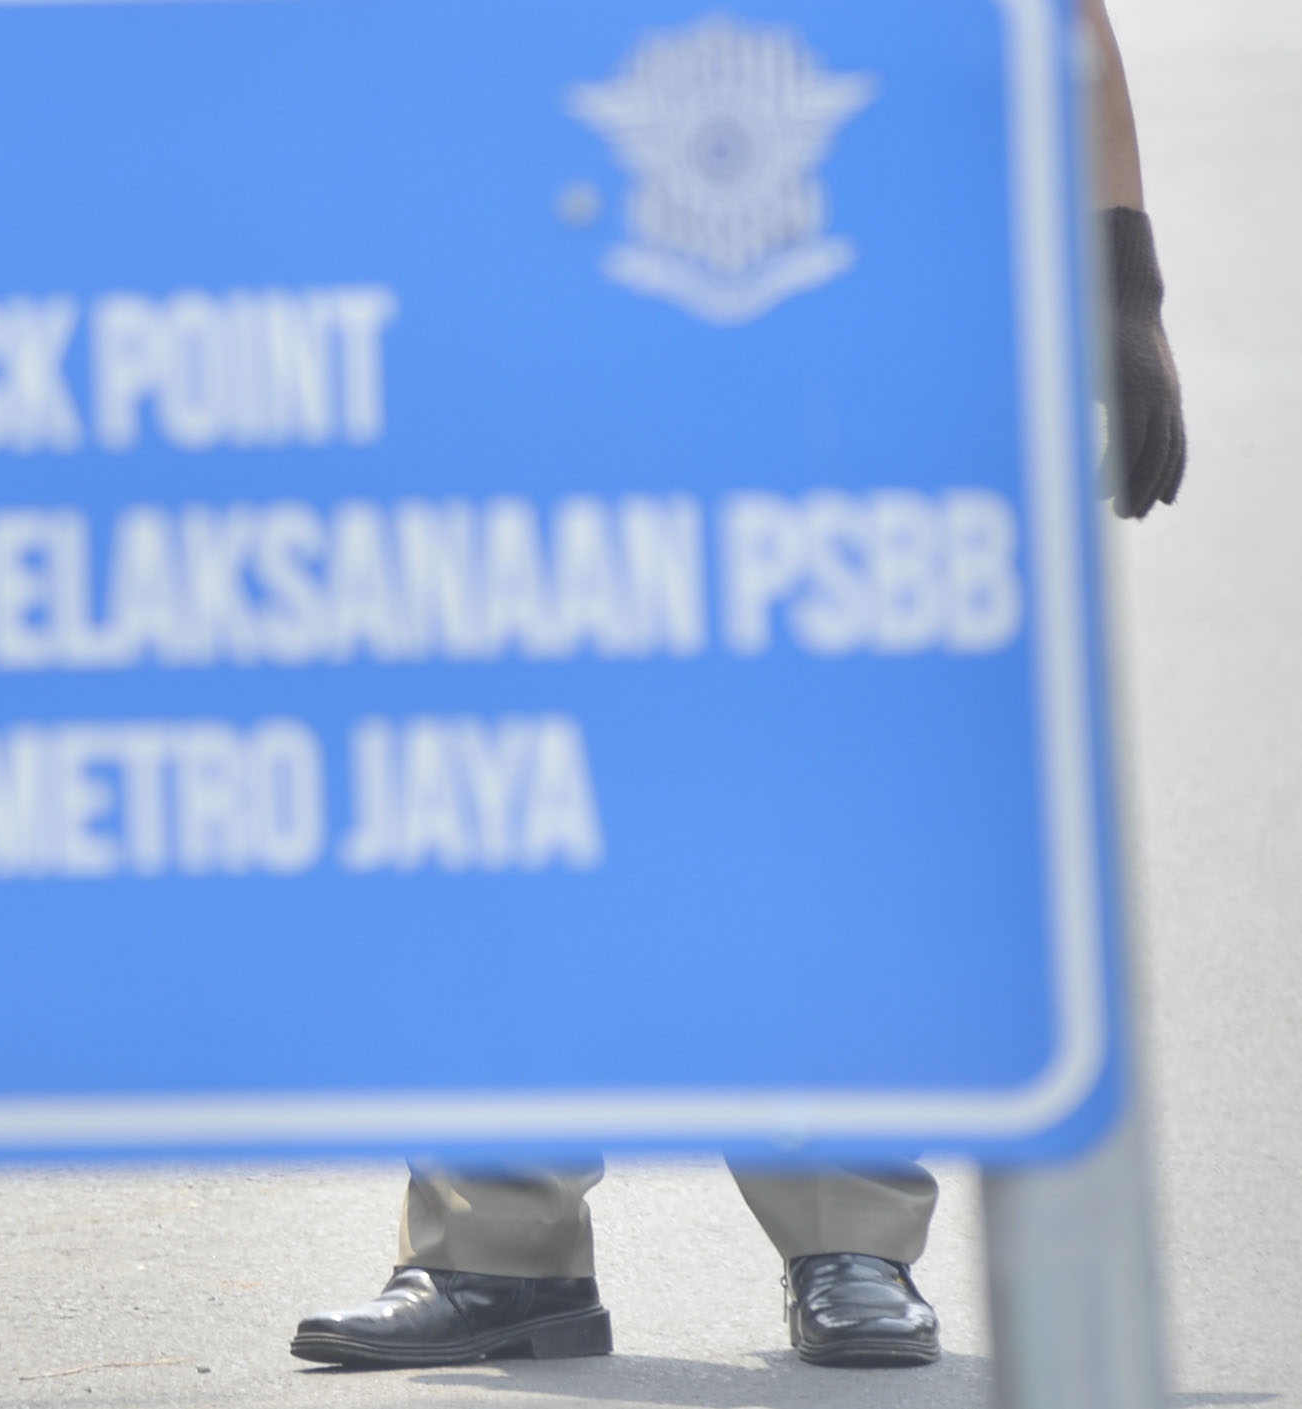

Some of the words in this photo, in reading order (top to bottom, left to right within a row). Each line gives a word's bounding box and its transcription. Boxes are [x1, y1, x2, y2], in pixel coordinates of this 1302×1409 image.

[89, 284, 398, 449] POINT
[719, 485, 1025, 656] PSBB
[336, 710, 606, 873] JAYA
